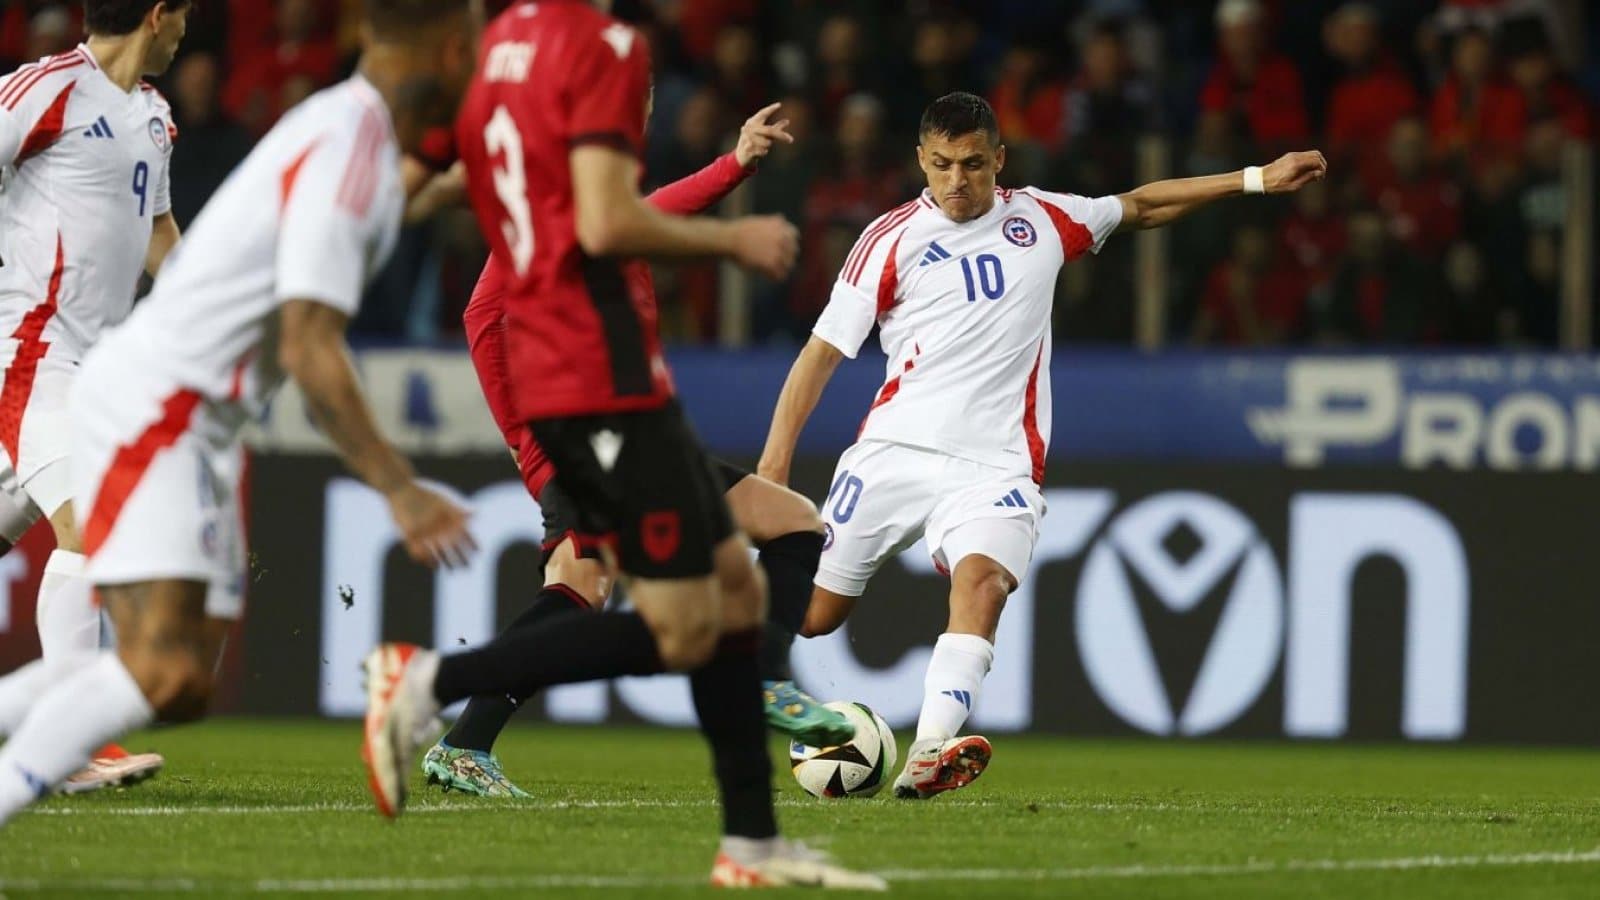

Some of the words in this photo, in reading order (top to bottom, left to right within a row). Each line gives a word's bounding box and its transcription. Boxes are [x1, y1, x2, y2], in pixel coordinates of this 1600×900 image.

[132, 160, 148, 216] 9
[483, 104, 536, 280] 3
[960, 253, 1005, 302] 10
[828, 469, 864, 525] 10
[319, 478, 1469, 738] mcron
